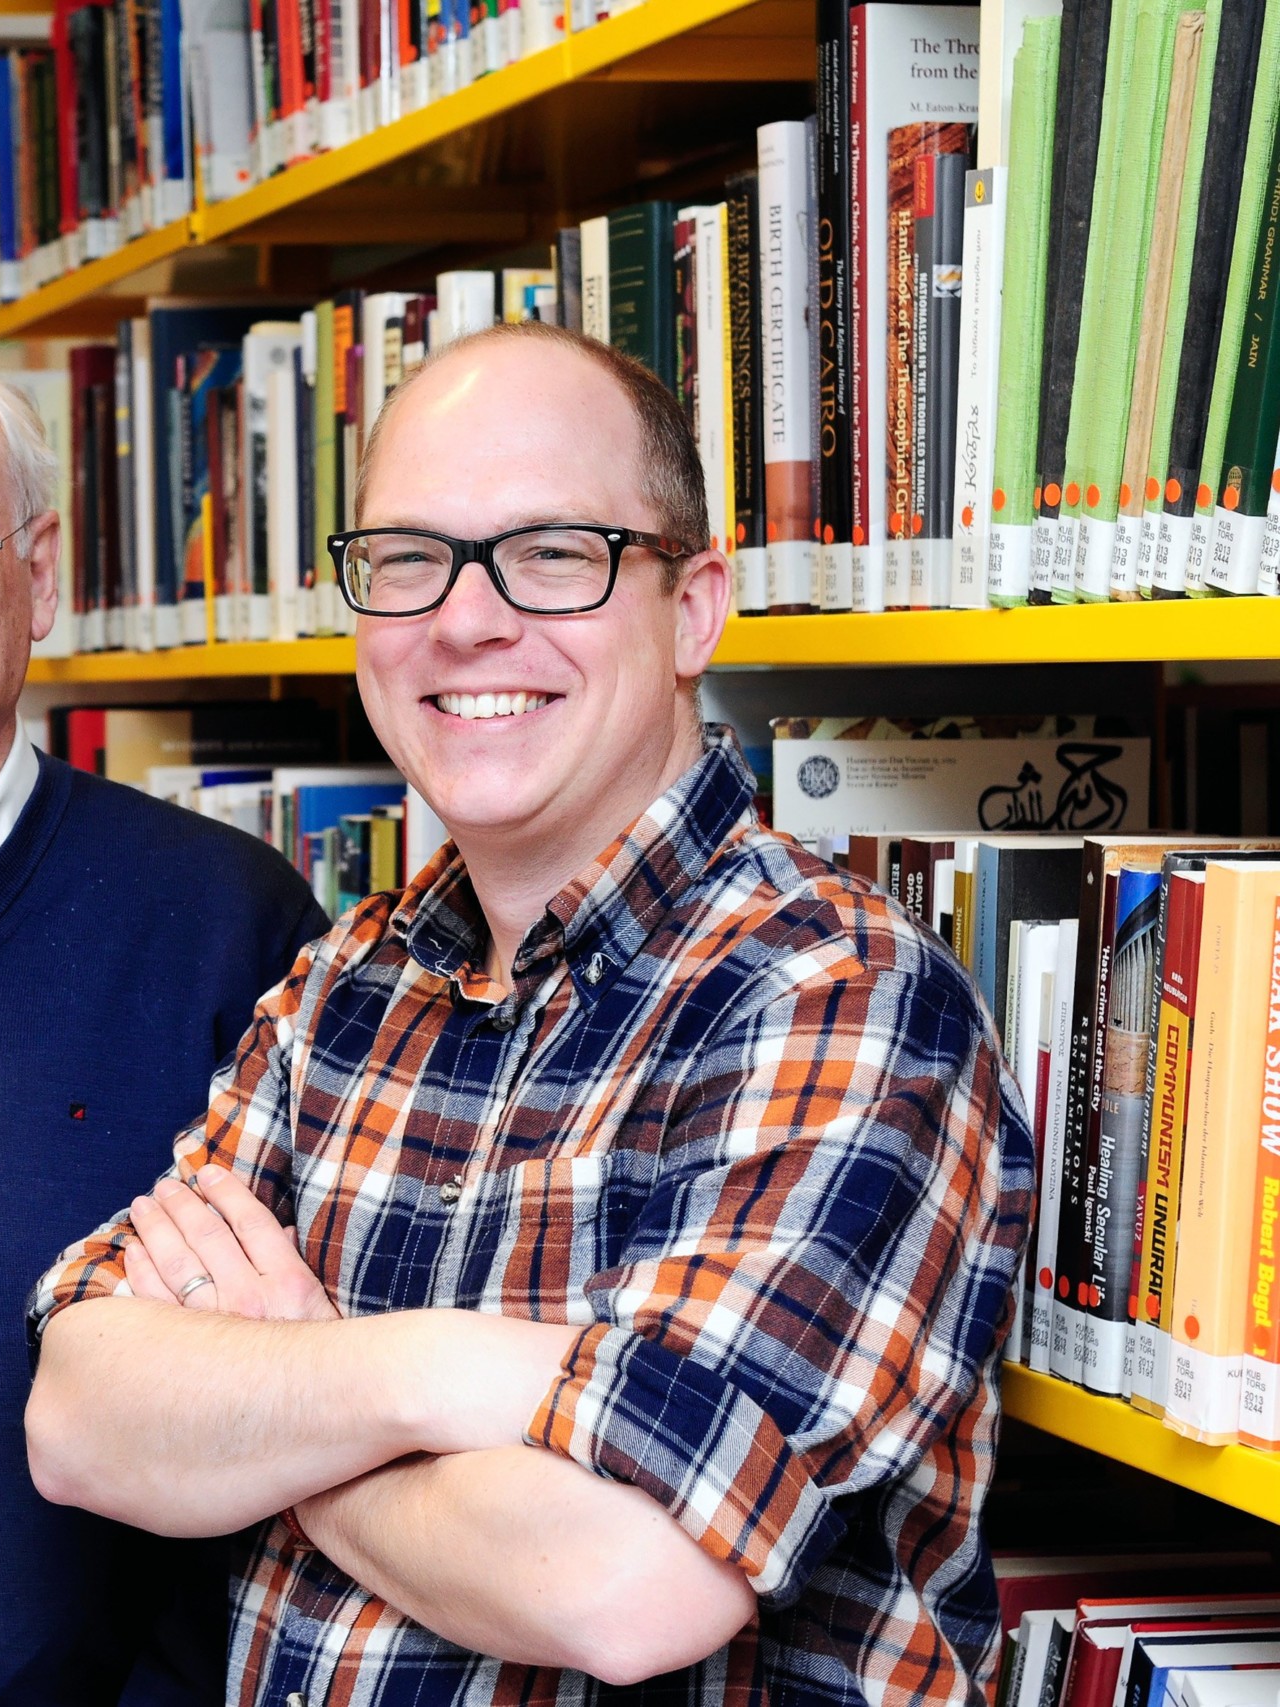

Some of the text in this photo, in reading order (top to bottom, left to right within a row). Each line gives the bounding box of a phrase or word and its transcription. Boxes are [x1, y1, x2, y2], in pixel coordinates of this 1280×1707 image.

[910, 38, 941, 54] The
[910, 63, 978, 80] from the
[909, 102, 979, 113] M. Eaton-Kra
[1270, 178, 1280, 222] HINDI
[836, 259, 844, 275] The
[1258, 226, 1276, 301] GRAMMAR
[851, 25, 862, 527] M. The Thrones, Chairs, Stools, and Footstools from the Tomb of Tutankh
[738, 195, 751, 398] THE BEGINNINGS
[836, 278, 844, 308] History
[769, 205, 785, 444] BIRTH CERTIFICATE
[820, 218, 836, 458] OLD CAIRO
[837, 328, 845, 366] Religious
[894, 211, 911, 484] Handbook of the Theosophical
[1248, 334, 1260, 368] JAIN
[917, 272, 927, 516] NATIONALISM IN THE TROUBLED TRIANGLE
[838, 405, 846, 415] of
[1116, 524, 1126, 534] UB
[1192, 523, 1202, 533] UB
[1219, 520, 1231, 531] KUB
[1115, 534, 1131, 544] ORS
[1141, 530, 1155, 541] ORS
[1159, 531, 1172, 542] ORS
[1191, 532, 1206, 544] ORS
[1217, 528, 1234, 541] TORS
[1263, 535, 1280, 548] 2013
[1113, 546, 1127, 557] 013
[1139, 543, 1151, 554] 013
[1157, 544, 1169, 555] 013
[1189, 545, 1202, 557] 013
[1214, 542, 1231, 555] 2013
[1188, 555, 1201, 566] 410
[1213, 552, 1229, 564] 2444
[1052, 569, 1070, 581] Kvart
[1137, 569, 1149, 578] vart
[1154, 570, 1167, 580] vart
[1211, 566, 1228, 581] Kvart
[891, 863, 900, 898] RELIG
[1071, 1034, 1079, 1058] ON
[1095, 1029, 1105, 1056] and
[1093, 1057, 1104, 1081] the
[1135, 882, 1168, 1242] Toward an Islamic Enlightenment YAVUZ
[1067, 1067, 1077, 1139] ISLAMIC
[1090, 1084, 1102, 1112] city
[1071, 1016, 1089, 1205] REFLECTIONS
[1086, 1165, 1097, 1193] Paul
[1146, 1024, 1180, 1329] COMMUNISM UNWRAP
[1084, 1196, 1094, 1243] Iganski
[1091, 1135, 1116, 1307] Healing Secular Lif
[1259, 1176, 1280, 1257] Robert
[1252, 1262, 1275, 1357] Bogd
[1140, 1335, 1153, 1346] KUB
[1139, 1344, 1156, 1357] TORS
[1138, 1356, 1154, 1369] 2013
[1177, 1356, 1190, 1368] KUB
[1176, 1366, 1195, 1379] TORS
[1246, 1369, 1261, 1380] KUB
[1175, 1378, 1192, 1392] 2013
[1246, 1379, 1266, 1392] TORS
[1174, 1387, 1191, 1402] 3241
[1244, 1391, 1263, 1405] 2013
[1244, 1401, 1263, 1414] 3244
